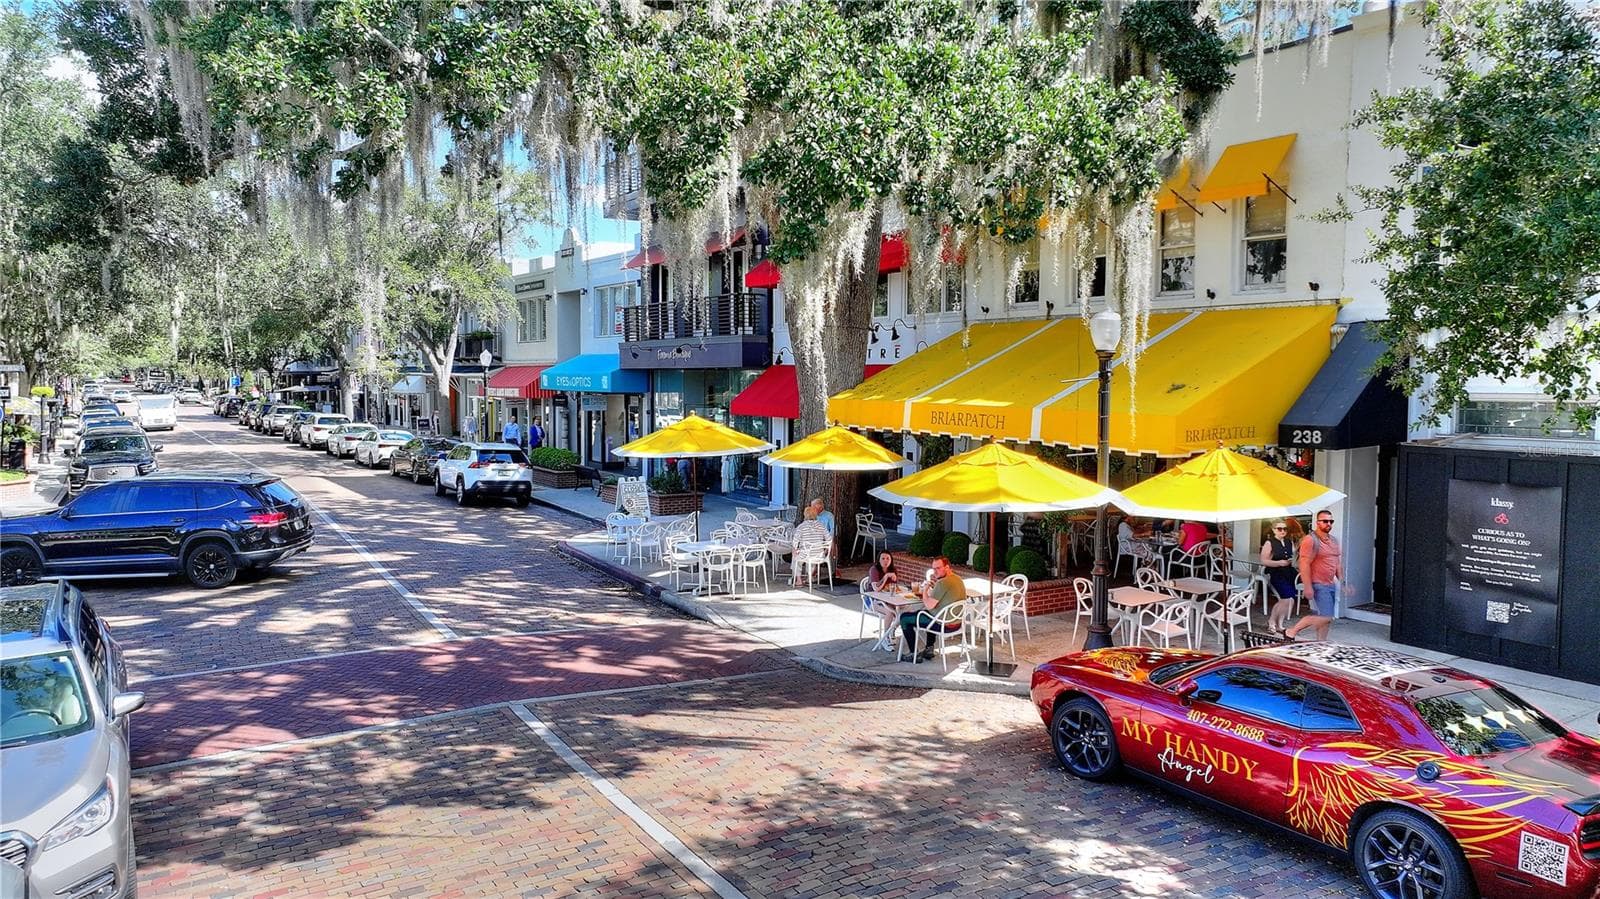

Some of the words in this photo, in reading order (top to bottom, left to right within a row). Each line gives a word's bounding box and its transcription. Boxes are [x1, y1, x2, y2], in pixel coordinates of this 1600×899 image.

[930, 410, 1005, 430] BRIARPATCH
[1185, 426, 1256, 443] BRIARPATCH
[1292, 430, 1322, 444] 238
[1471, 533, 1496, 542] WHAT'S
[1495, 536, 1518, 545] GOING
[1517, 539, 1531, 547] ON?
[1477, 527, 1505, 536] CURIOUS
[1515, 531, 1526, 539] TO
[1186, 709, 1265, 743] 407-272-8688
[1121, 716, 1157, 746] MY
[1164, 731, 1259, 782] HANDY
[1157, 747, 1215, 784] Angel
